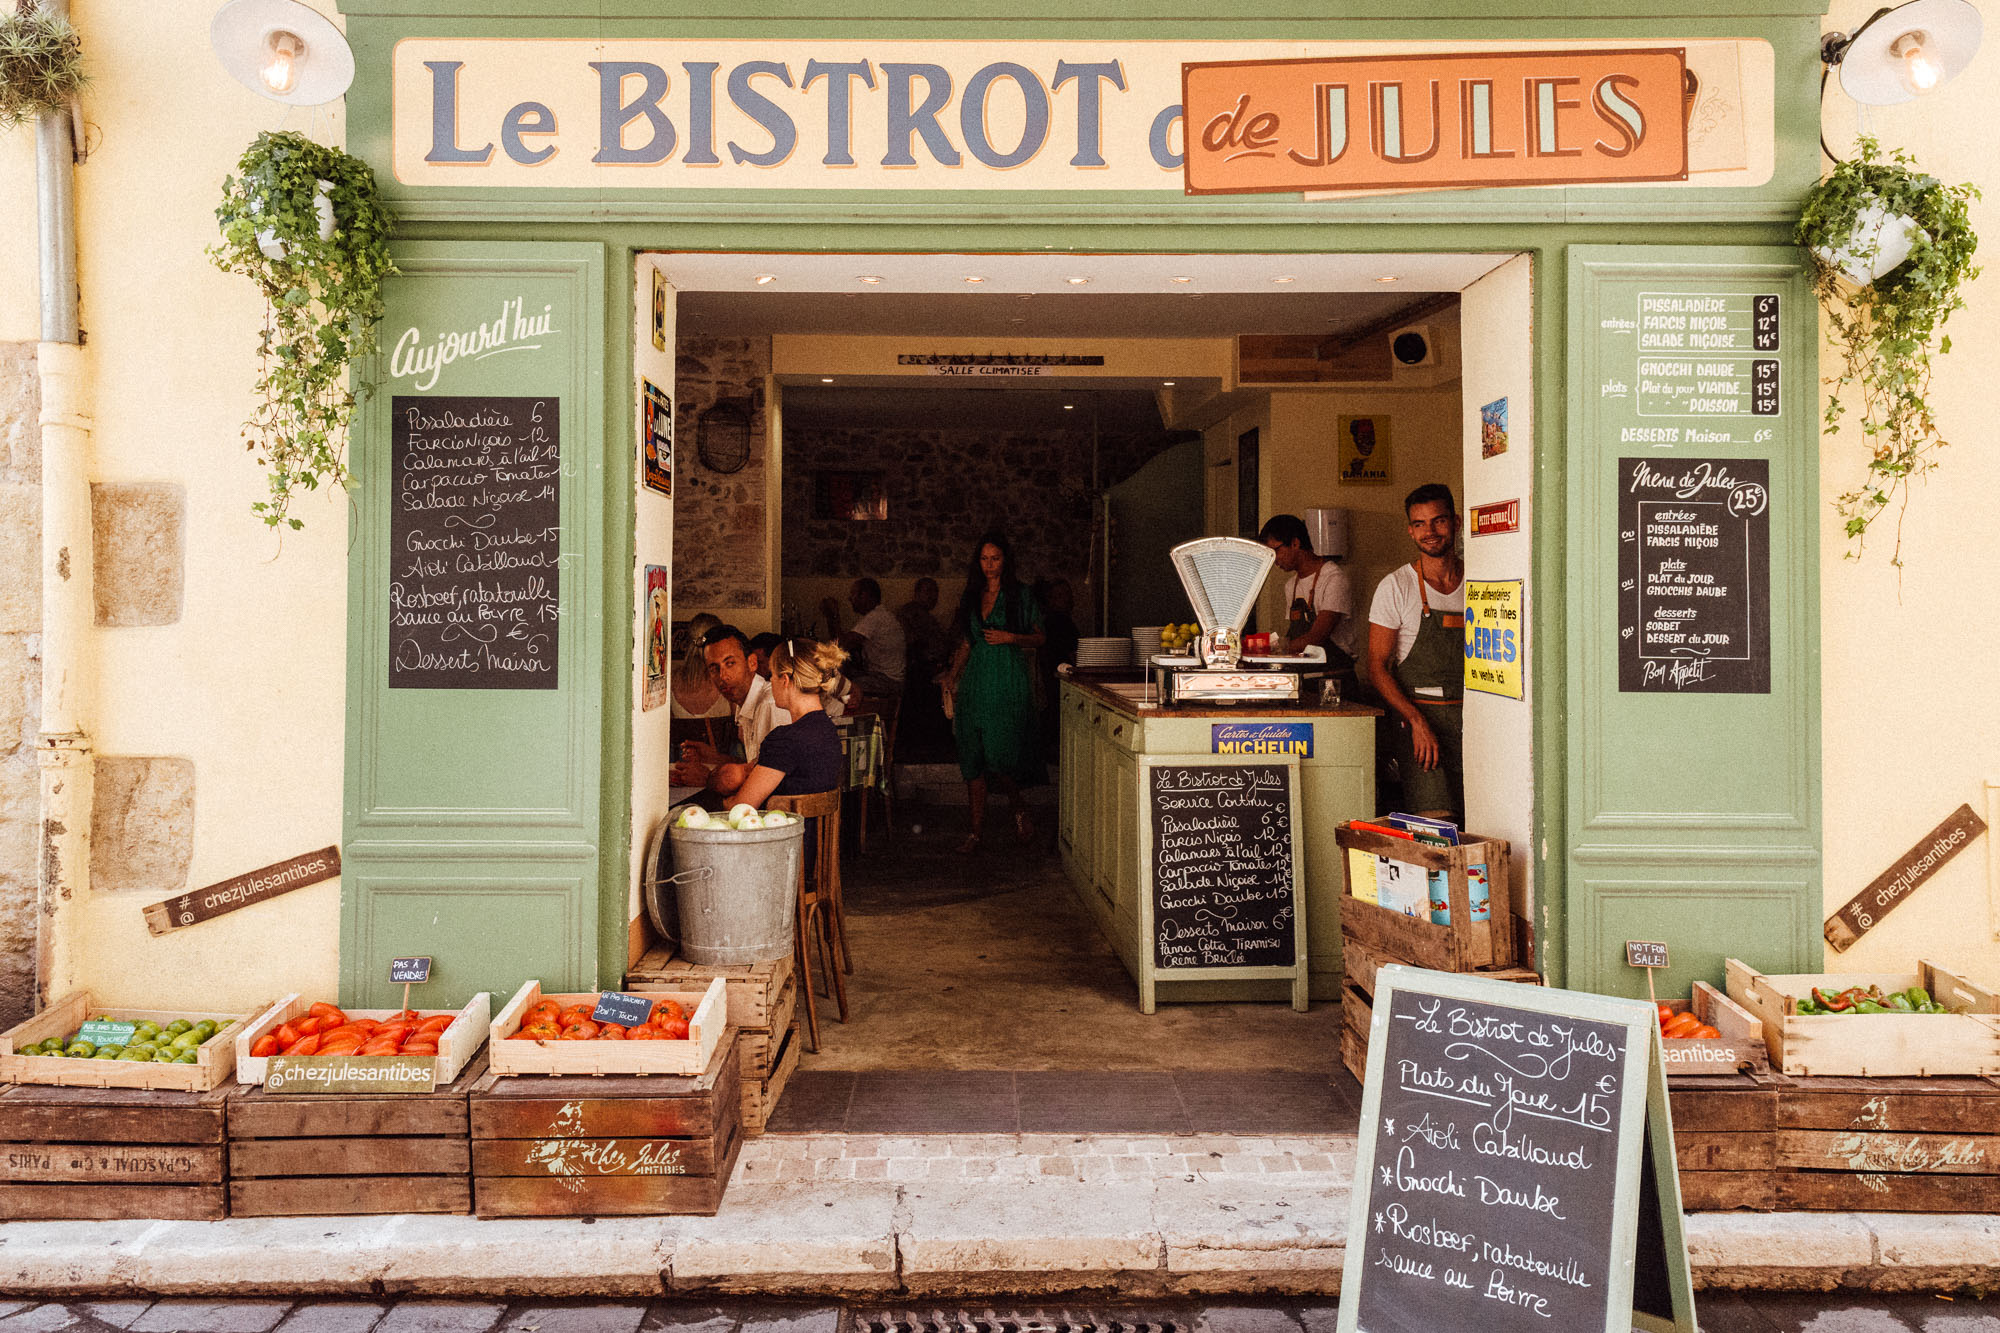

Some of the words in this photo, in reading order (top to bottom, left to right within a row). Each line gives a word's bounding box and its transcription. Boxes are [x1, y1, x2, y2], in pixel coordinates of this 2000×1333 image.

[423, 60, 560, 168] Le
[588, 58, 1128, 169] BISTROT
[1201, 93, 1280, 154] de
[1286, 72, 1648, 167] JULES
[1643, 297, 1726, 313] PISSALADIÈRE
[1601, 317, 1635, 329] entrées
[1643, 315, 1686, 331] FARCIS
[1689, 316, 1728, 333] NIÇOIS
[390, 296, 561, 391] Aujourd'hui
[1641, 333, 1684, 347] SALADE
[1689, 333, 1736, 349] NIÇOISE
[938, 366, 975, 376] SALLE
[1641, 362, 1693, 377] GNOCCHI
[1696, 363, 1735, 377] DAUBE
[1601, 378, 1628, 397] plats
[1641, 380, 1661, 394] Plat
[1662, 383, 1673, 394] du
[1672, 385, 1695, 398] jour
[1697, 381, 1740, 395] VIANDE
[1689, 399, 1738, 413] POISSON
[1621, 427, 1680, 443] DESSERTS
[1685, 428, 1731, 443] Maison
[1630, 460, 1676, 493] Menu
[1675, 462, 1742, 499] Jules
[1679, 471, 1696, 488] de
[1655, 509, 1698, 522] entrées
[1646, 523, 1719, 536] PISSALADIÈRE
[470, 528, 537, 551] Daube
[1646, 536, 1680, 547] FARCIS
[1684, 536, 1719, 549] NIÇOIS
[1660, 557, 1688, 574] plats
[1648, 574, 1672, 584] PLAT
[1674, 574, 1686, 584] du
[1687, 574, 1715, 585] JOUR
[1646, 586, 1693, 597] GNOCCHIS
[1696, 586, 1727, 597] DAUBE
[1654, 606, 1698, 619] desserts
[1645, 621, 1681, 632] SORBET
[1646, 633, 1686, 644] DESSERT
[1688, 633, 1701, 644] du
[1702, 633, 1730, 645] JOUR
[1642, 661, 1666, 687] Bon
[1218, 726, 1250, 739] Cartes
[1256, 726, 1292, 741] Guides
[1218, 740, 1308, 755] MICHELIN
[1156, 769, 1174, 790] Le
[1177, 770, 1228, 788] Bistrot
[1243, 769, 1282, 800] Jules
[1876, 827, 1967, 907] chezjulesantibes
[204, 859, 327, 909] chezjulesantibes
[1629, 943, 1650, 952] NOT
[1651, 945, 1667, 954] FOR
[393, 960, 409, 969] PAS
[1415, 999, 1442, 1034] Le
[1447, 1008, 1524, 1043] Bistrot
[1528, 1024, 1554, 1047] de
[1663, 1044, 1736, 1063] santibes
[285, 1062, 432, 1087] chezjulesantibes
[1398, 1060, 1454, 1089] Plats
[1457, 1075, 1496, 1098] du
[1473, 1122, 1592, 1170] Cabillaud
[9, 1153, 51, 1170] PARIS
[634, 1165, 686, 1175] ANTIBES
[1396, 1145, 1467, 1198] Gnocchi
[1474, 1175, 1567, 1220] Daube
[1375, 1247, 1436, 1280] sauce
[1444, 1268, 1475, 1289] au
[1483, 1241, 1592, 1288] ratatouille
